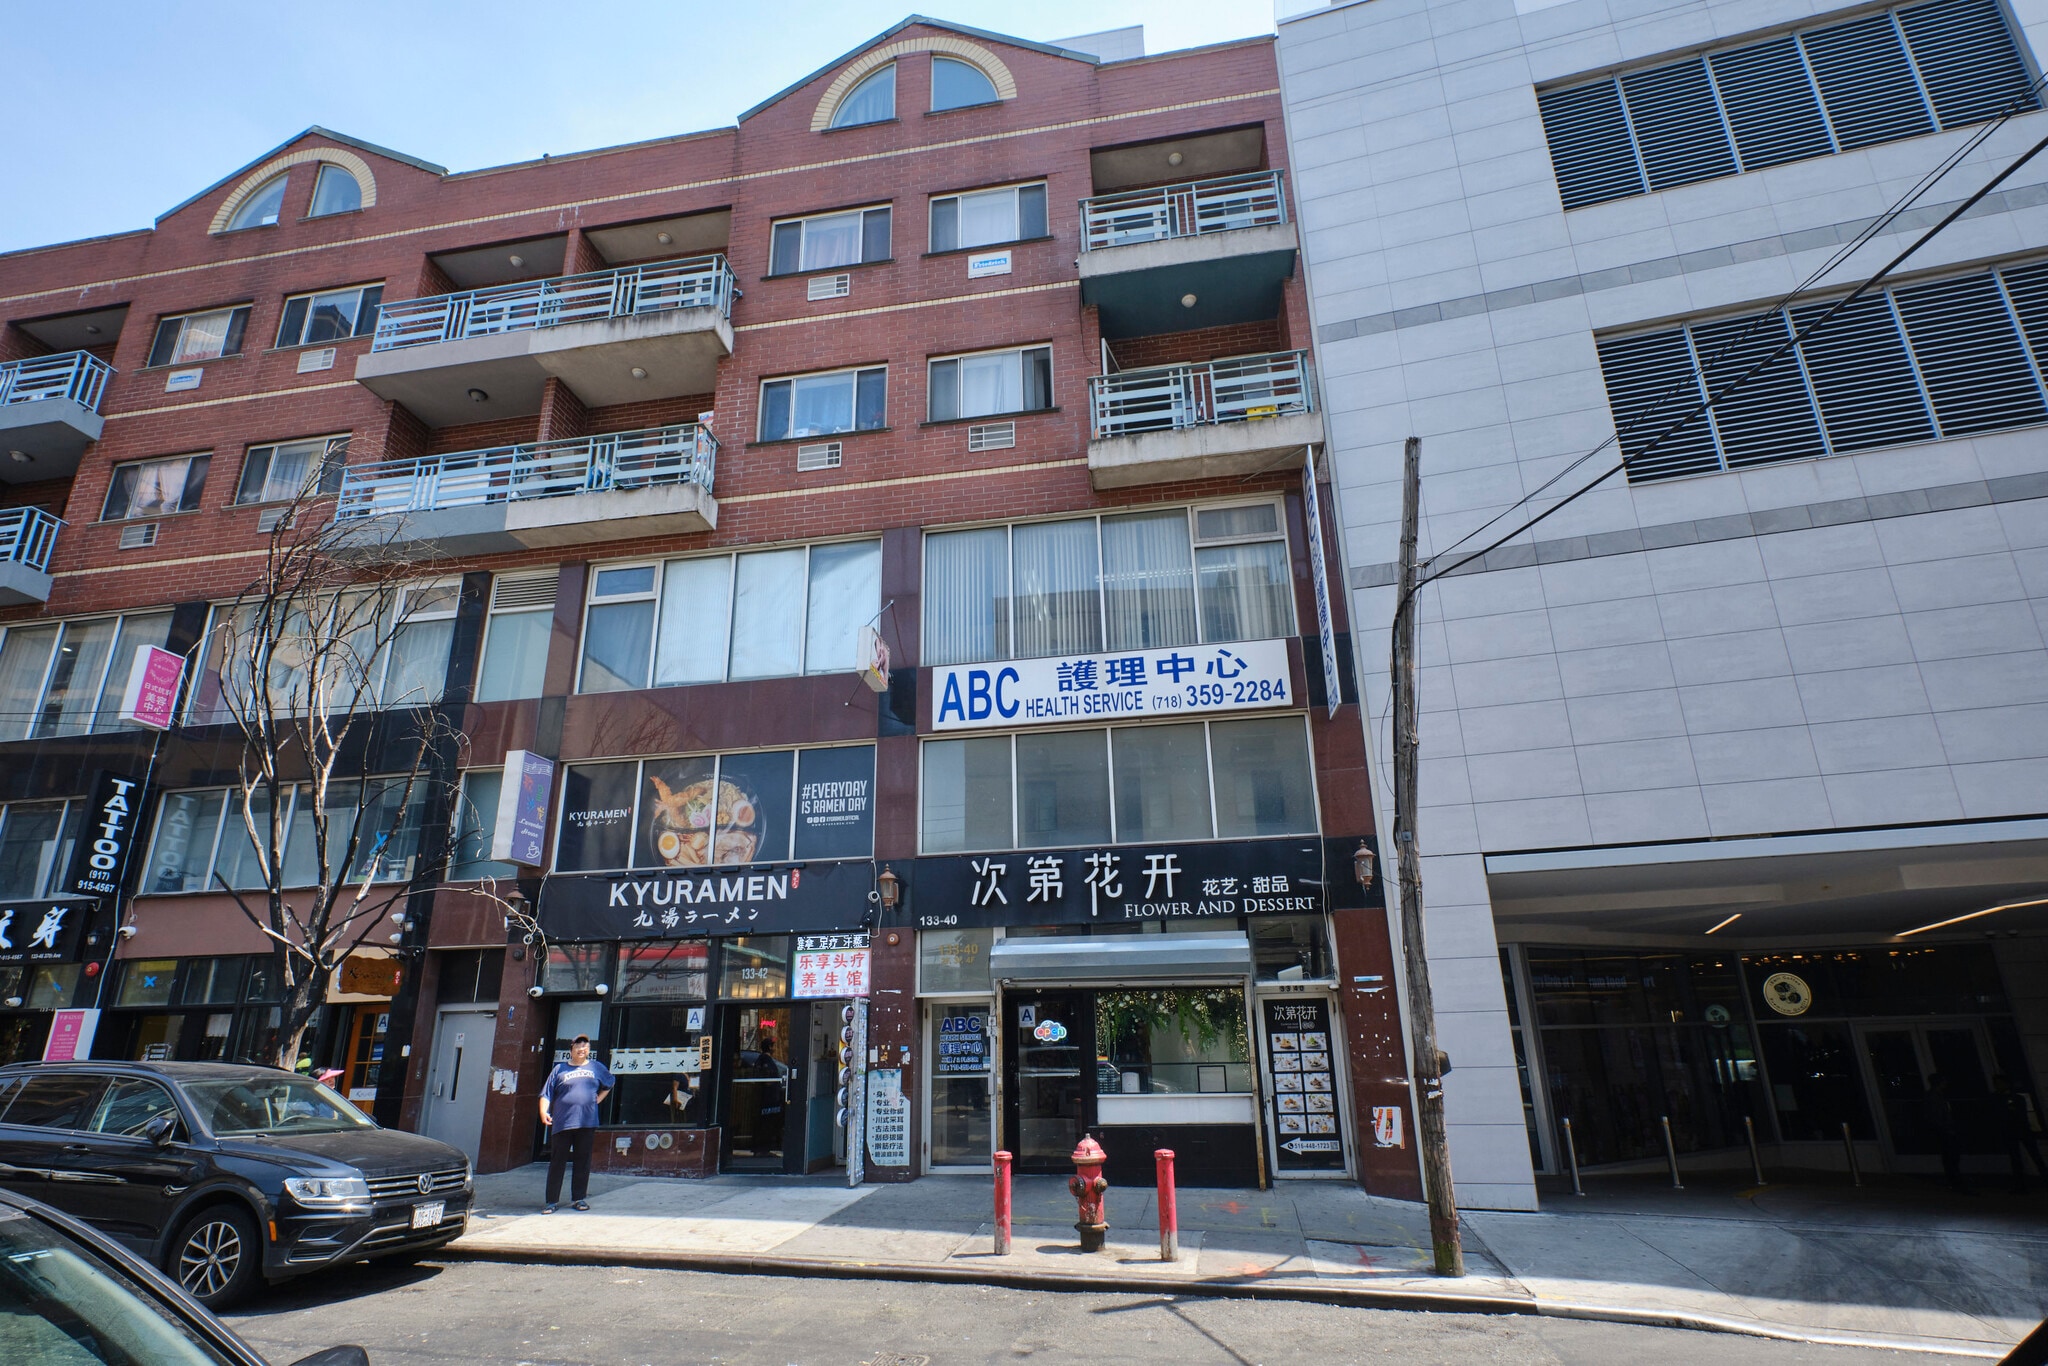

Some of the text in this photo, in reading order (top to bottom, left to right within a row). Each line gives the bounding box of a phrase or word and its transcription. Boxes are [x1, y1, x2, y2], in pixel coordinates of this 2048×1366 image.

[1057, 648, 1248, 692] 護理中心
[938, 667, 1020, 723] ABC
[1026, 678, 1286, 718] HEALTH SERVICE (718) 359-2284
[143, 702, 164, 715] 中心
[801, 780, 867, 800] #EVERYDAY
[801, 797, 867, 814] IS RAMEN DAY
[569, 809, 628, 821] KYURAMEN
[89, 778, 136, 870] TATTOO
[89, 869, 111, 881] (917)
[77, 880, 115, 893] 915-4567
[609, 875, 788, 907] KYURAMEN
[971, 852, 1182, 916] 次第花开
[1124, 896, 1315, 918] FLOWER AND DESSERT
[920, 914, 957, 926] 133-40
[938, 943, 979, 955] 133-40
[800, 952, 866, 970] 乐享头疗
[742, 967, 768, 979] 133-42
[801, 970, 863, 988] 养生馆
[378, 1015, 388, 1028] A
[690, 1011, 700, 1023] A
[1021, 1009, 1032, 1021] A
[940, 1016, 981, 1032] ABC
[1037, 1027, 1064, 1038] open
